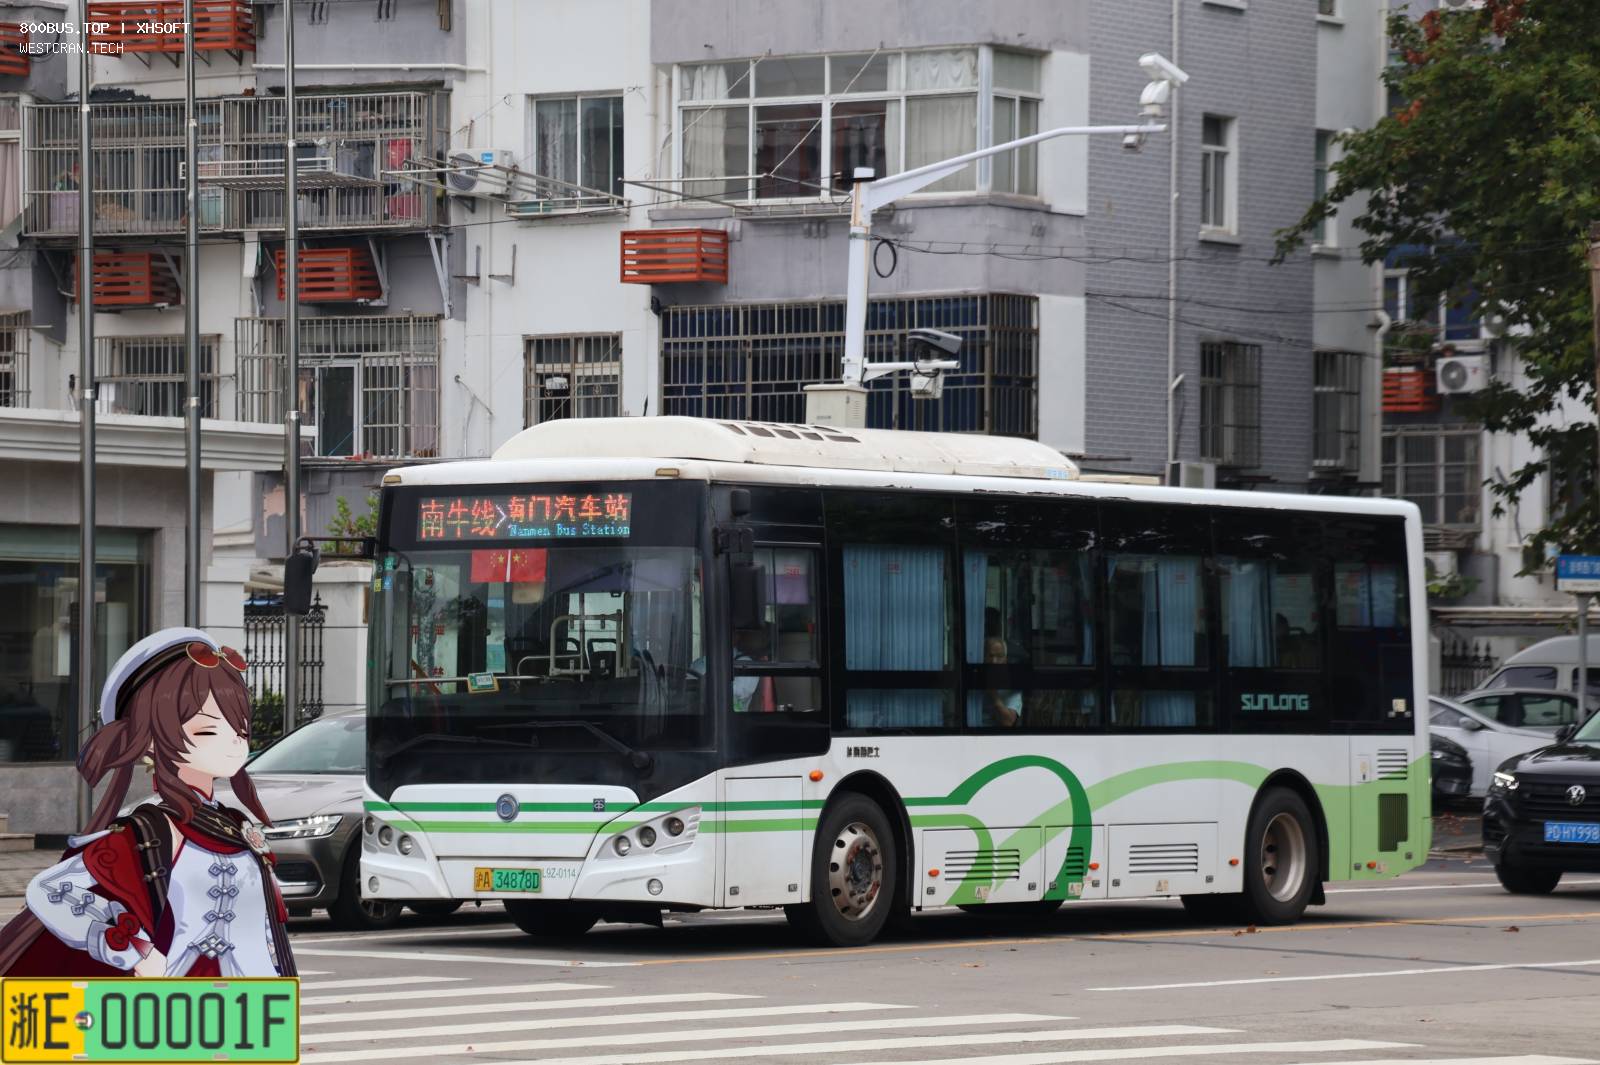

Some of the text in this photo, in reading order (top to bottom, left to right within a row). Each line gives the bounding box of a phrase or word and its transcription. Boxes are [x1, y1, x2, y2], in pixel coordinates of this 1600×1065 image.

[420, 498, 497, 539] 南牛线
[509, 521, 630, 536] Nanmen Bus Station
[1241, 694, 1309, 711] SUNLONG
[495, 871, 540, 889] 34878D
